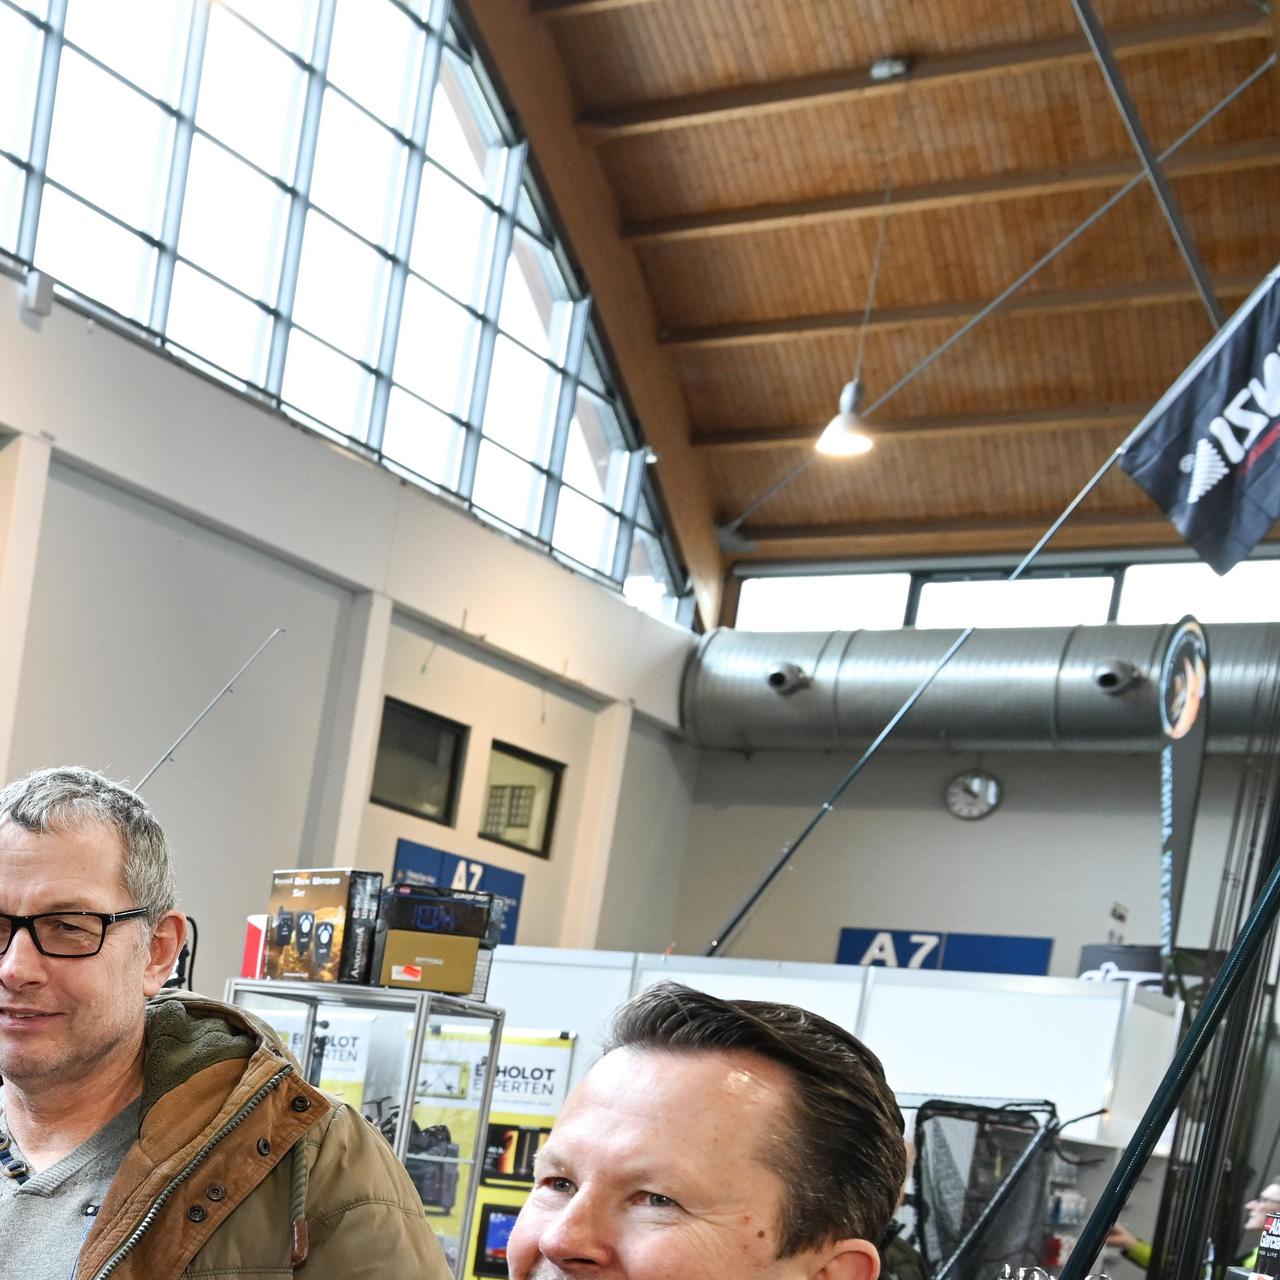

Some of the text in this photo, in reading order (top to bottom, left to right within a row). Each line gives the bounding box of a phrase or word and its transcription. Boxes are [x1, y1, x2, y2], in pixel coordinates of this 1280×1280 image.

[859, 932, 941, 970] A7
[475, 1063, 557, 1082] EHOLOT
[473, 1080, 555, 1097] EPERTEN
